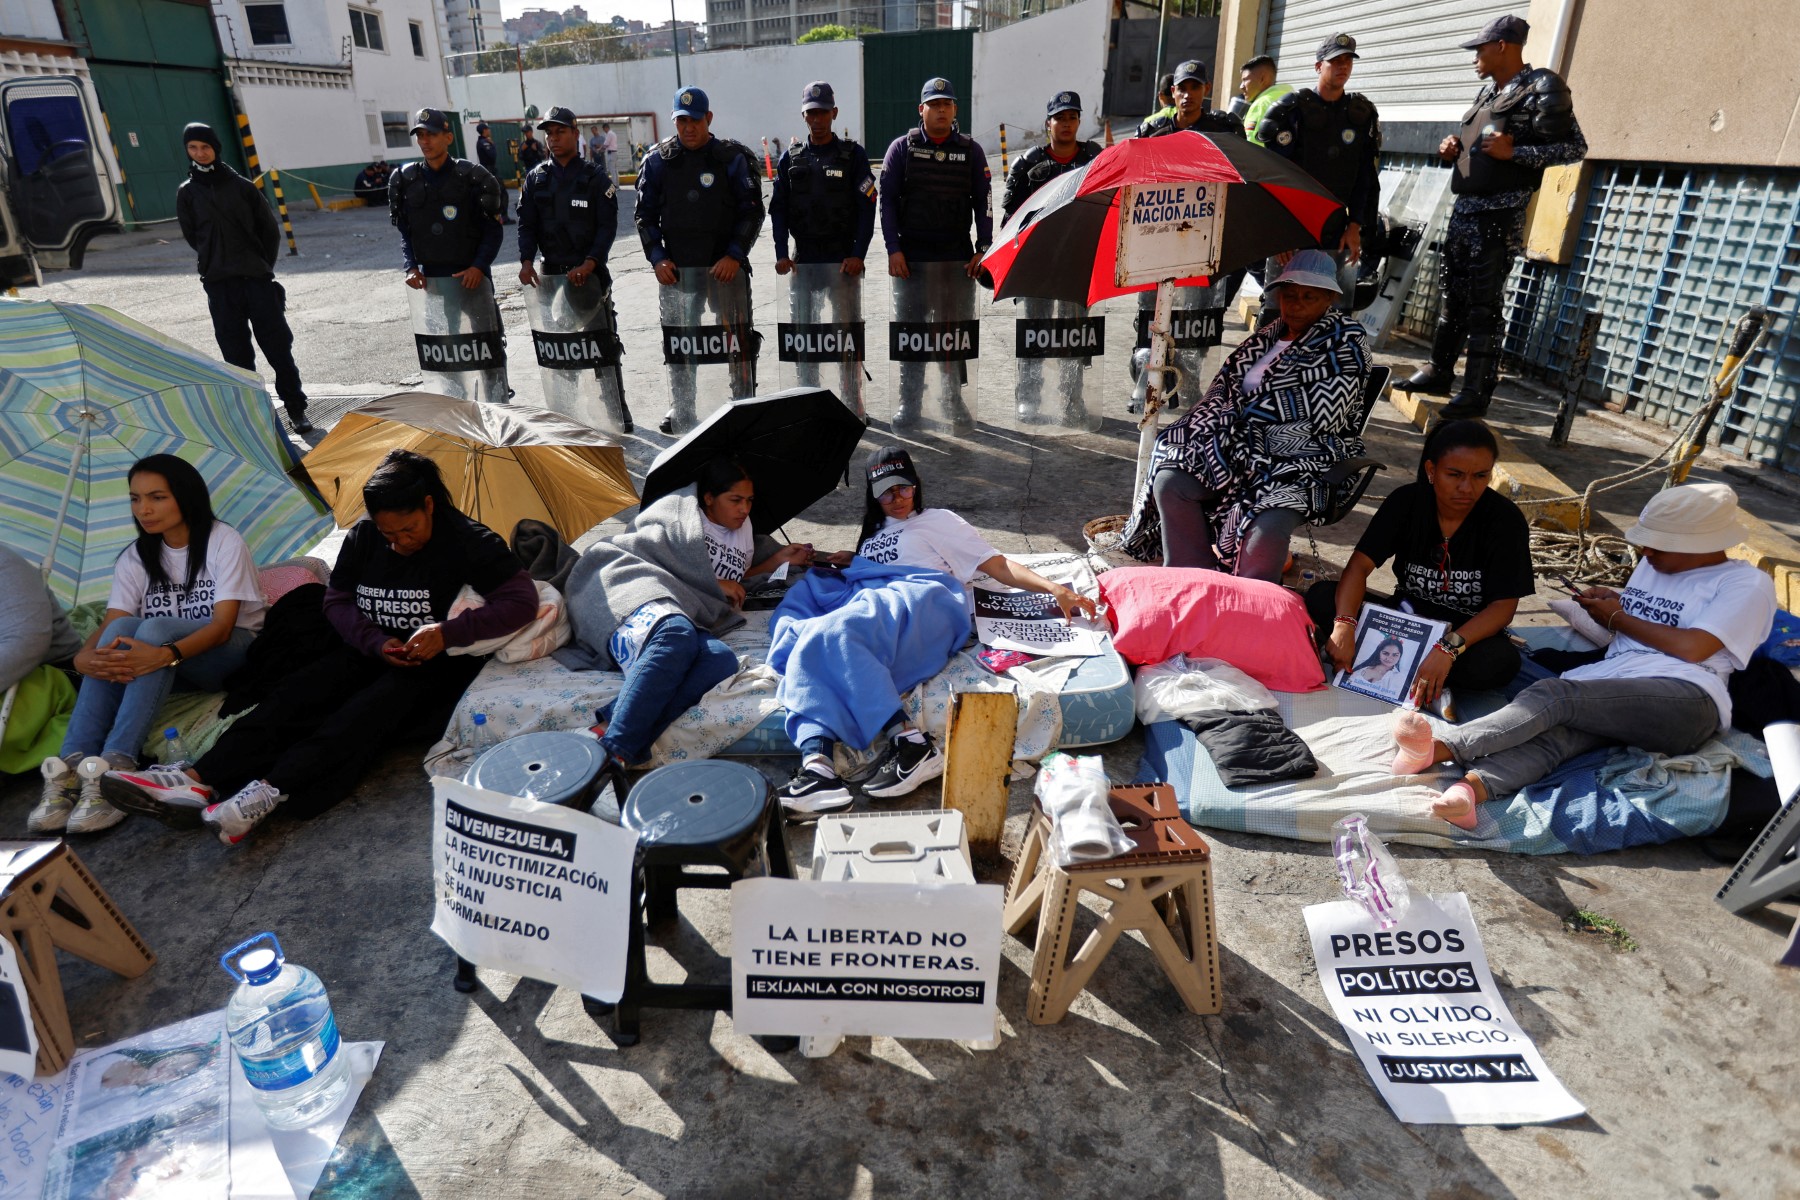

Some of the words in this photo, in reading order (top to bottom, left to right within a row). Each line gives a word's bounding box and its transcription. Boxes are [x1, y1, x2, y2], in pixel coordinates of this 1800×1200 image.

[1025, 324, 1098, 348] POLICÍA
[1148, 316, 1216, 339] LICÍA
[422, 339, 493, 363] POLICÍA
[537, 336, 602, 361] POLICÍA
[670, 332, 741, 355] POLICÍA
[784, 330, 856, 353] POLICÍA
[898, 328, 972, 352] POLICÍA
[705, 543, 718, 556] OS
[720, 550, 746, 572] PRES
[711, 558, 744, 584] ÍTICO
[1405, 563, 1438, 580] IBEREN
[1450, 570, 1482, 580] TODOS
[1408, 574, 1426, 588] OS
[146, 596, 172, 609] LOS
[356, 584, 386, 598] LIBEREN
[388, 590, 394, 598] A
[396, 590, 430, 599] TODOS
[376, 600, 432, 614] PRESOS
[978, 601, 1058, 612] LIDARIDAD,
[1012, 610, 1042, 618] MÁS
[1620, 597, 1632, 610] OS
[1654, 598, 1684, 612] TODOS
[362, 612, 436, 630] ÍTICOS
[1378, 613, 1406, 624] LIBERTAD
[1408, 620, 1422, 628] PARA
[446, 808, 462, 828] EN
[463, 818, 569, 858] VENEZUELA,
[446, 832, 458, 848] LA
[460, 841, 609, 894] REVICTIMIZACIÓN
[444, 872, 455, 890] SE
[456, 881, 486, 904] HAN
[445, 852, 452, 866] Y
[452, 858, 465, 876] LA
[468, 866, 562, 902] INJUSTICIA
[444, 891, 550, 941] NORMALIZADO
[768, 924, 798, 942] LA
[807, 928, 922, 946] LIBERTAD
[932, 932, 967, 948] NO
[1330, 928, 1465, 958] PRESOS
[752, 948, 821, 966] TIENE
[831, 952, 980, 971] FRONTERAS.
[752, 979, 837, 995] ¡EXÍJANLA
[841, 982, 878, 995] CON
[883, 984, 980, 998] NOSOTROS!
[1340, 967, 1474, 992] POLÍTICOS
[1352, 1008, 1382, 1023] NI
[1390, 1004, 1504, 1024] OLVIDO,
[1366, 1032, 1392, 1046] NI
[1397, 1030, 1517, 1046] SILENCIO.
[1384, 1062, 1488, 1078] ¡JUSTICIA
[1490, 1062, 1532, 1077] YA!
